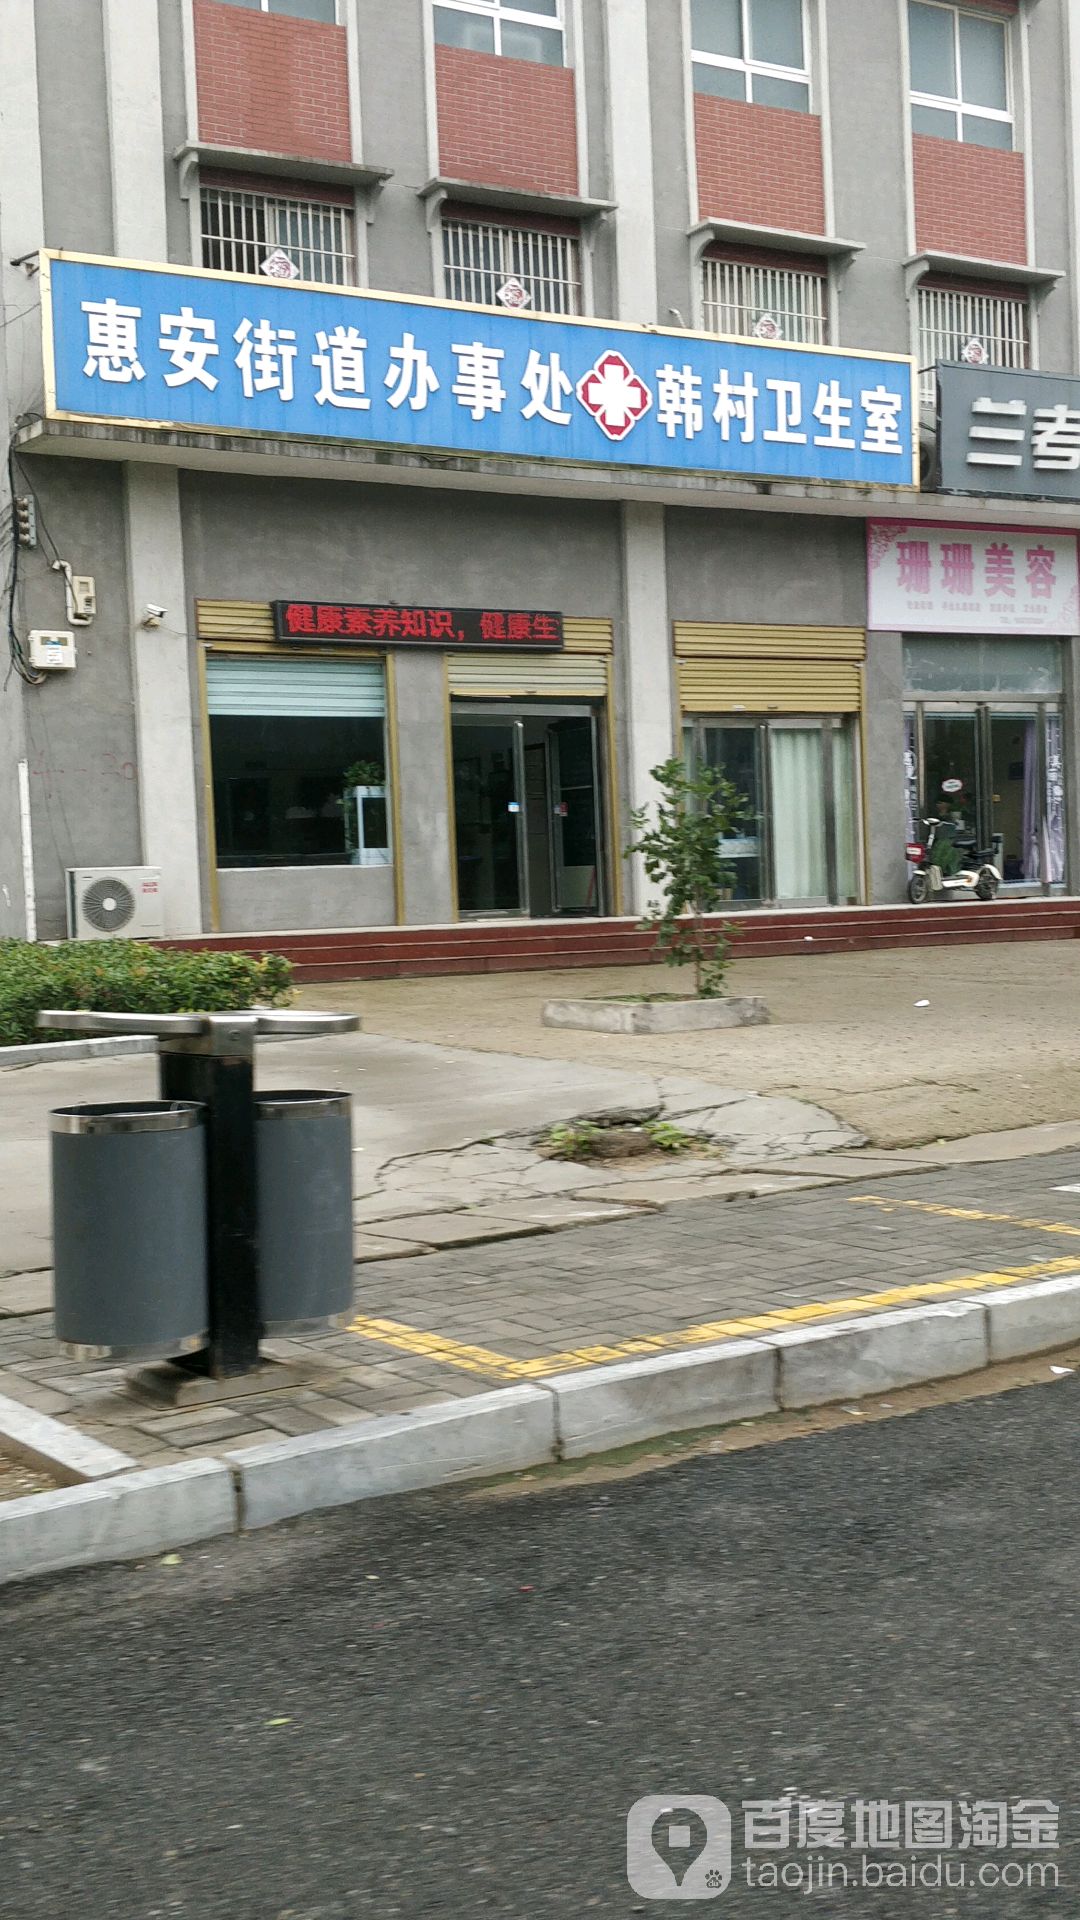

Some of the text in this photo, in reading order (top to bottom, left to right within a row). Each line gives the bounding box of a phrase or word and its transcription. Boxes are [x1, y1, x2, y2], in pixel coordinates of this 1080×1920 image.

[80, 298, 903, 455] 惠安街道办事处 韩村卫生室
[896, 540, 1057, 599] 珊珊美容
